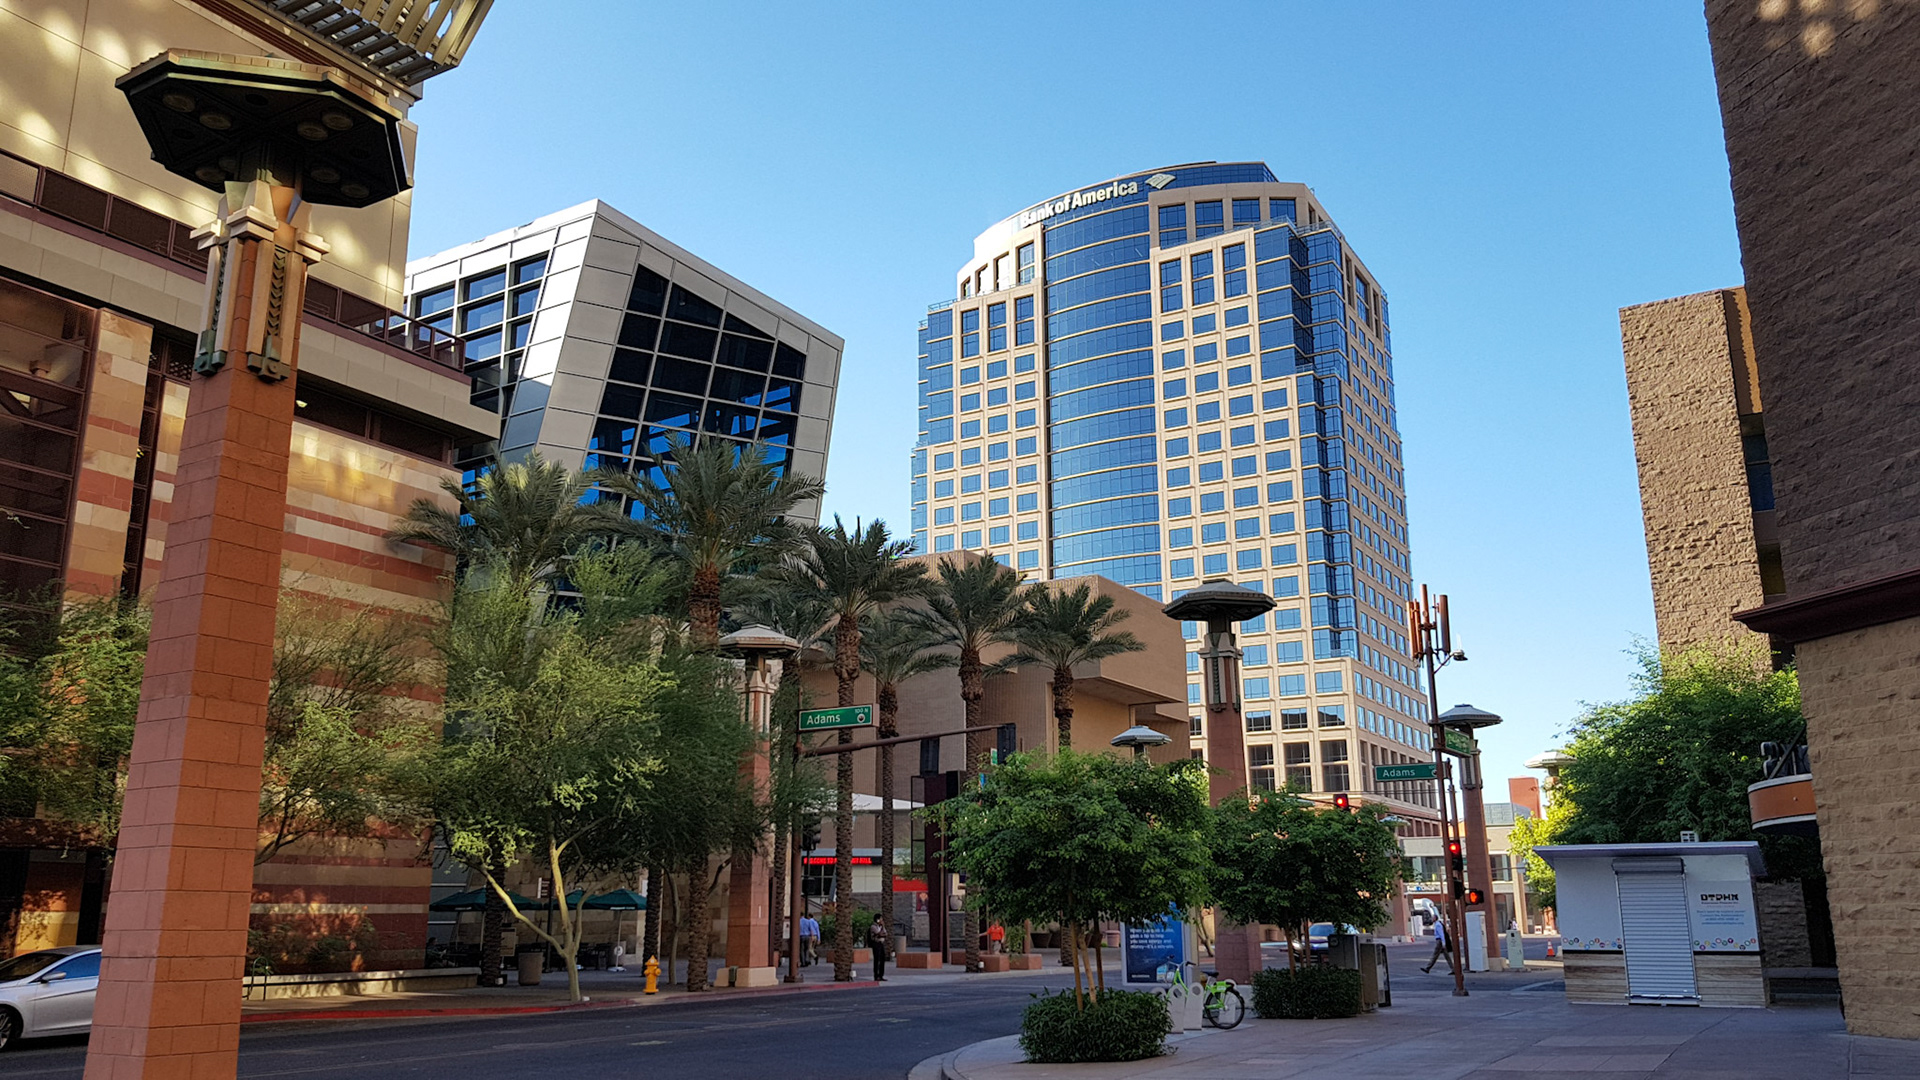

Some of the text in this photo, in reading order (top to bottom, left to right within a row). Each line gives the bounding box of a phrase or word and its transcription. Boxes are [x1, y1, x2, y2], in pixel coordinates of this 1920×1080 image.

[1020, 181, 1138, 228] Bank of America
[806, 714, 841, 725] Adams
[1382, 769, 1416, 778] Adams
